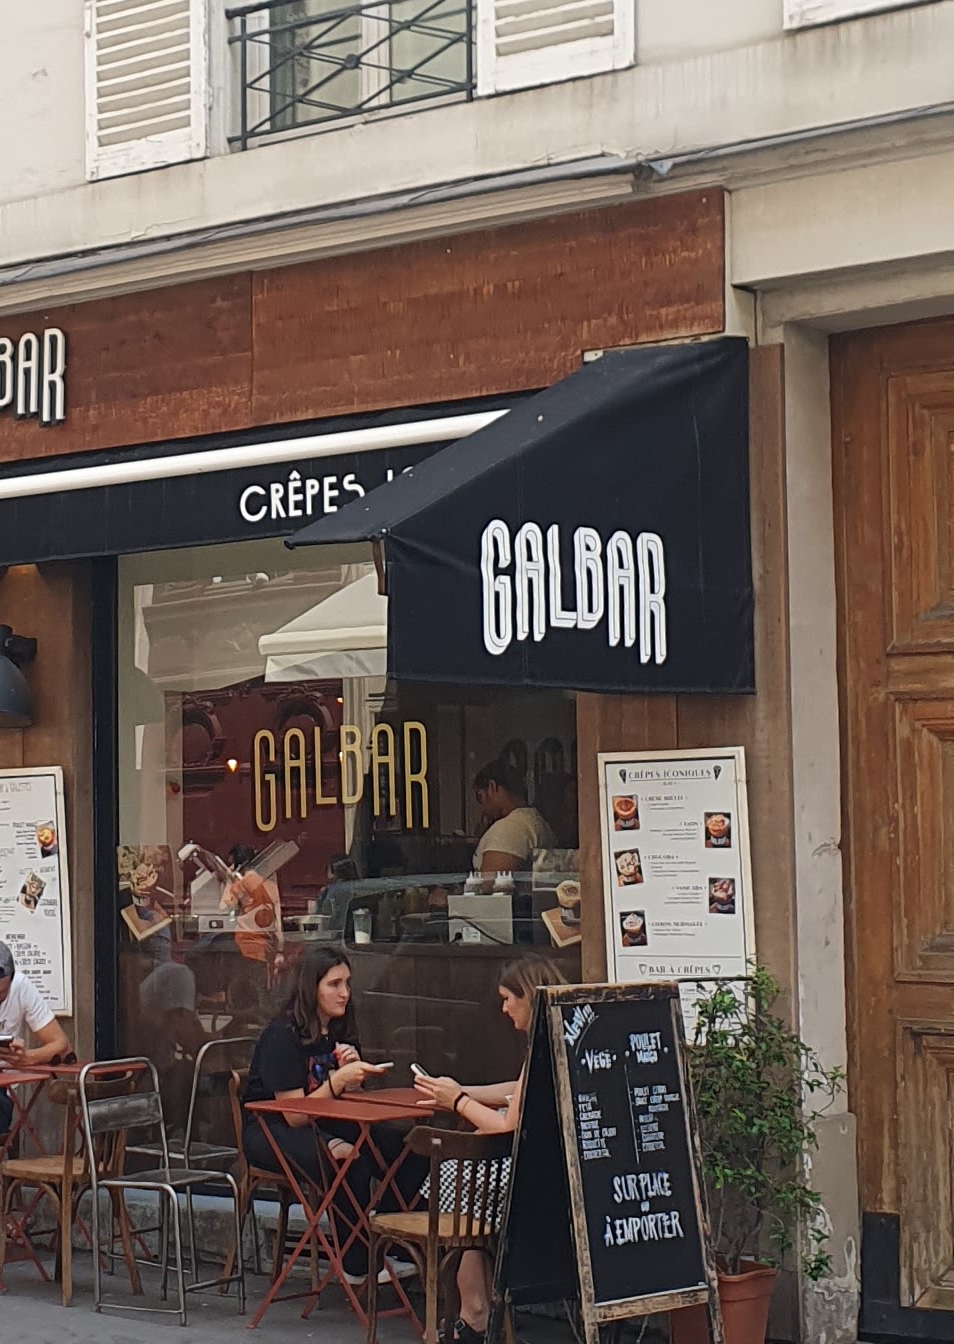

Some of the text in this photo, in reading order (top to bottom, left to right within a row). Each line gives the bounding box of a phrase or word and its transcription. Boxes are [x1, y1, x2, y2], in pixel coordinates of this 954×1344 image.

[481, 519, 667, 664] GALBAR
[254, 721, 429, 832] GALBAR
[613, 1171, 672, 1203] SUR PLACE
[604, 1210, 684, 1247] À EMPORTER
